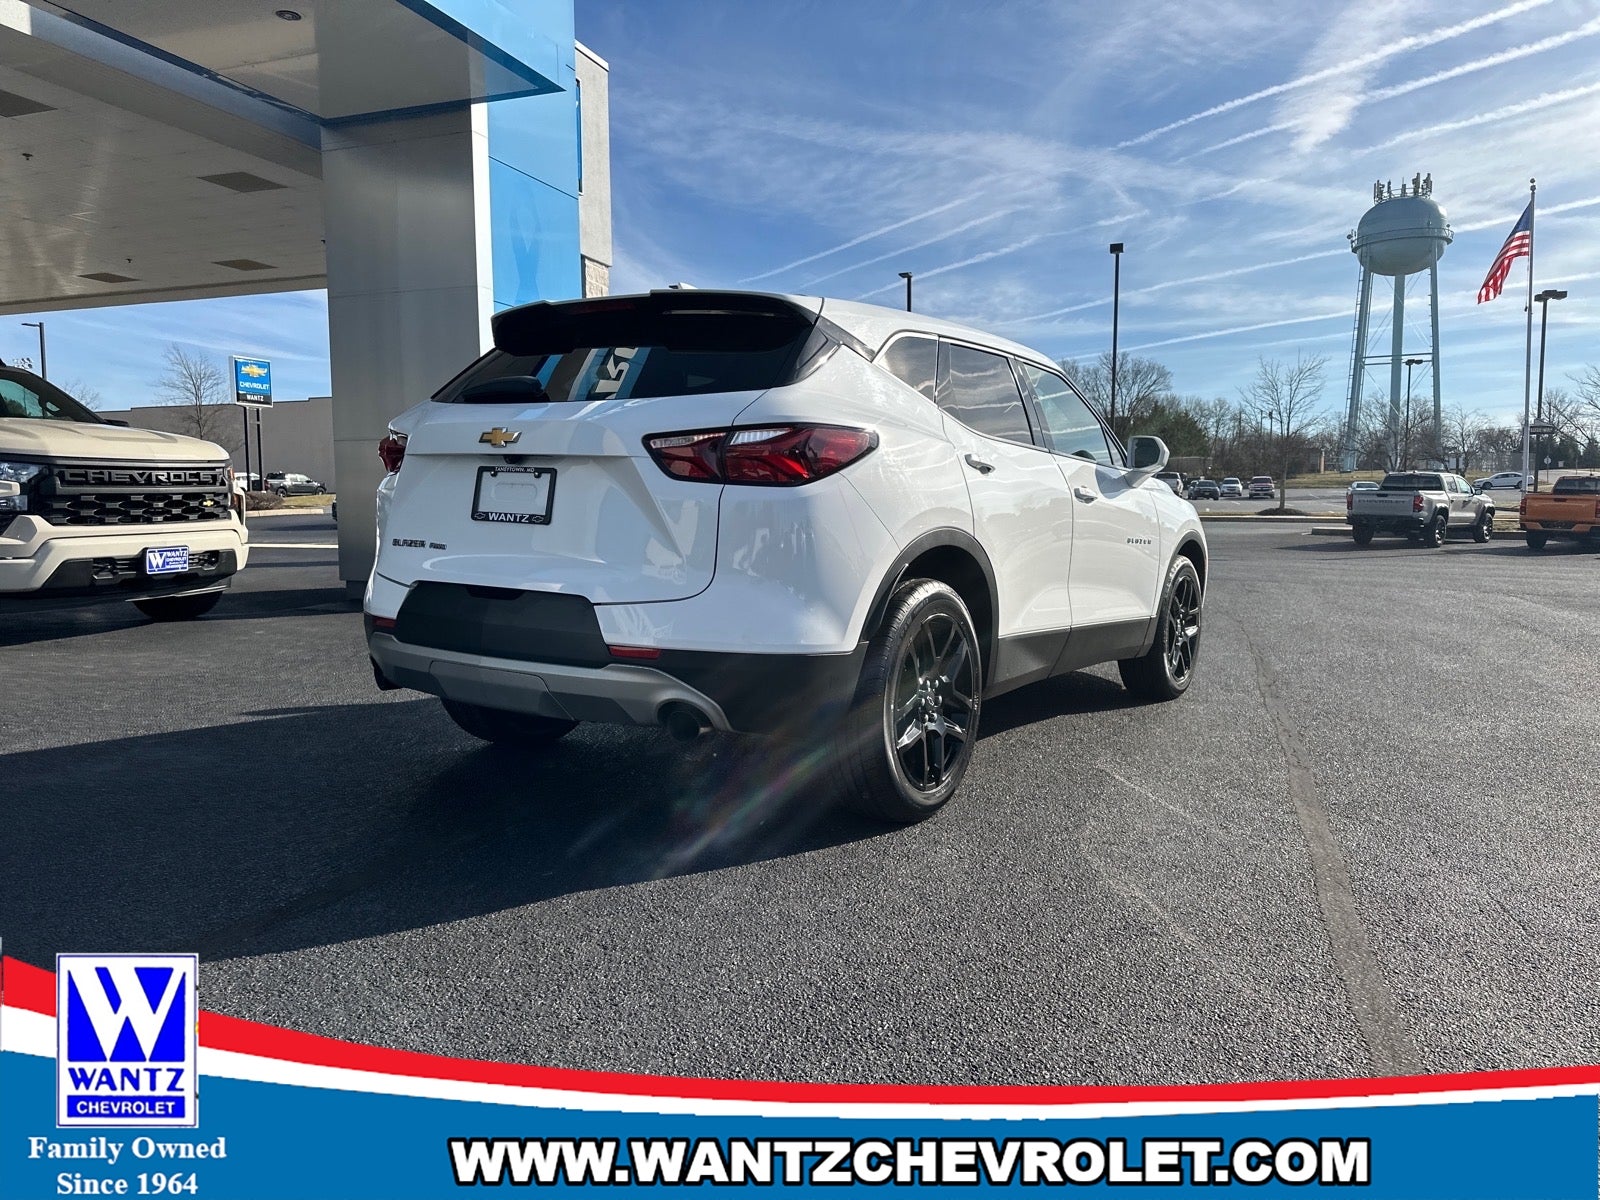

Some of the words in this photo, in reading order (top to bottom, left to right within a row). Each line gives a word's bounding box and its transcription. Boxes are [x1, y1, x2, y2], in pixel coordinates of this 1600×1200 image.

[239, 381, 270, 390] CHEVROLET
[246, 394, 264, 402] WANTZ
[65, 469, 223, 485] CHEVROLET
[488, 512, 529, 523] WANTZ
[392, 538, 426, 548] BLAZER
